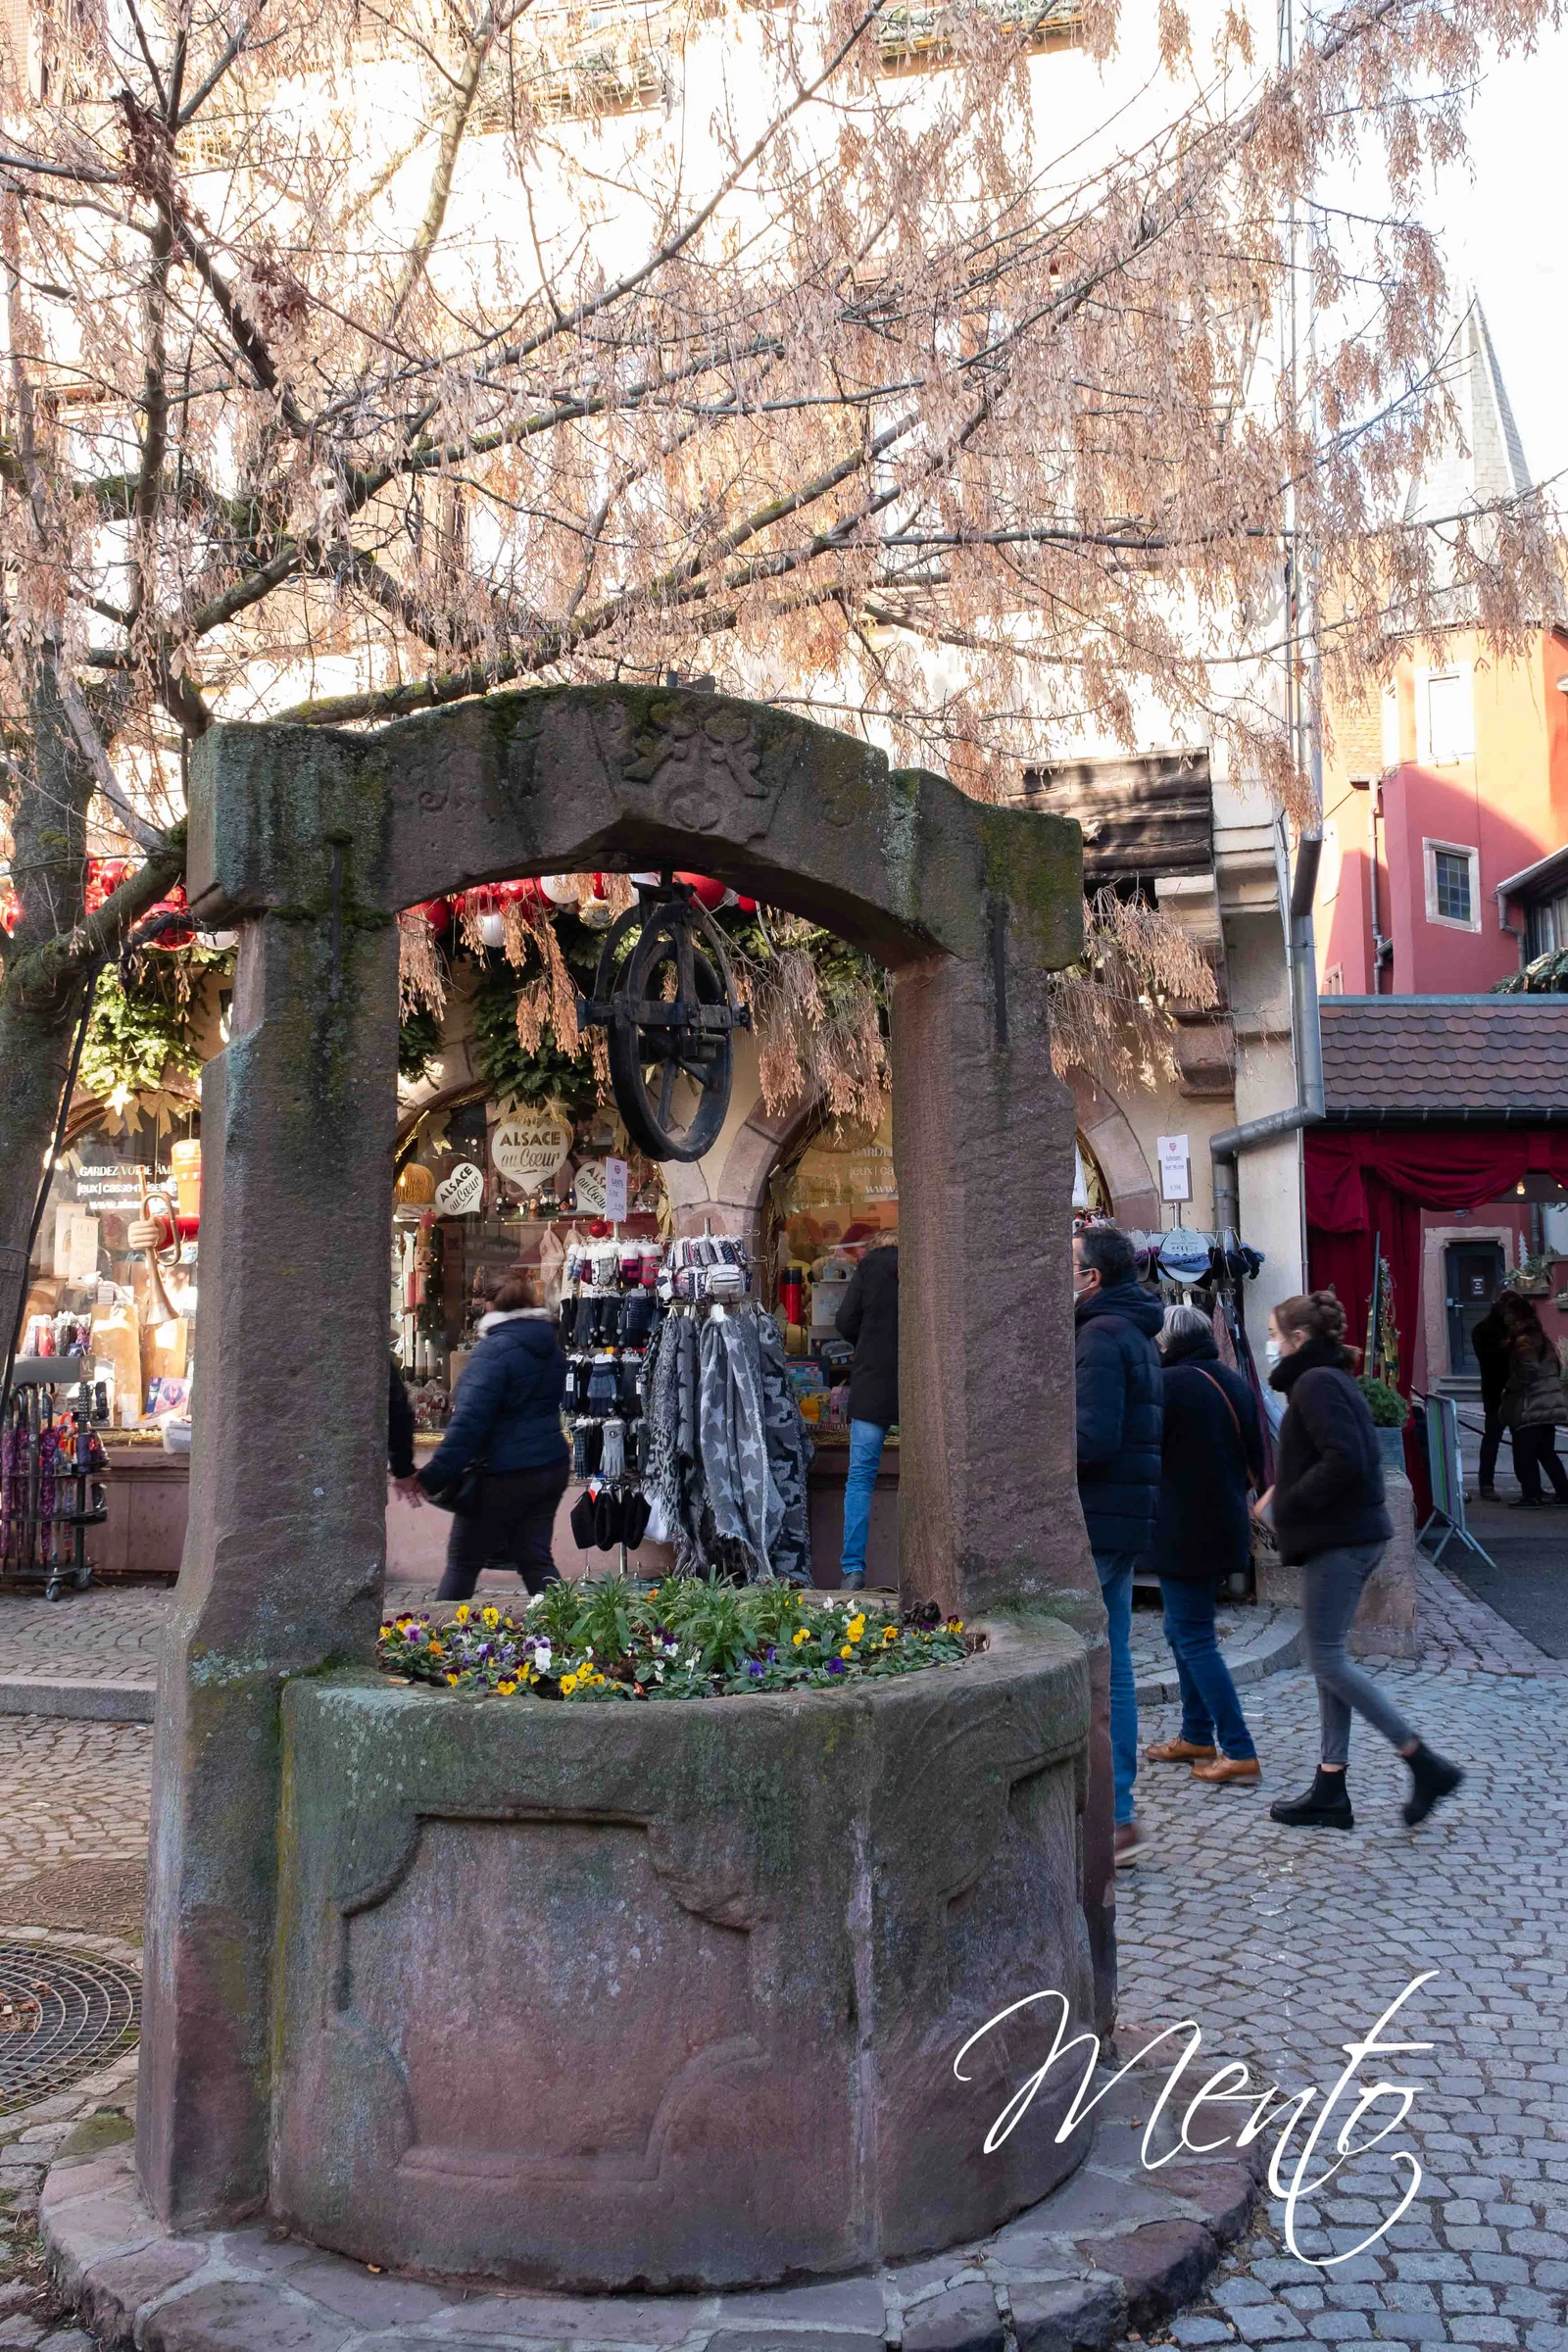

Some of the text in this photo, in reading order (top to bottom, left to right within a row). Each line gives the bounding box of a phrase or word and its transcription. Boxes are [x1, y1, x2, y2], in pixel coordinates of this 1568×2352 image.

[499, 1131, 562, 1147] ALSACE
[501, 1148, 561, 1167] au Cœur
[79, 1165, 119, 1176] GARDEZ
[440, 1165, 473, 1203] ALSACE
[449, 1176, 479, 1212] au Cœur
[577, 1177, 590, 1191] au
[587, 1185, 607, 1209] Cœu
